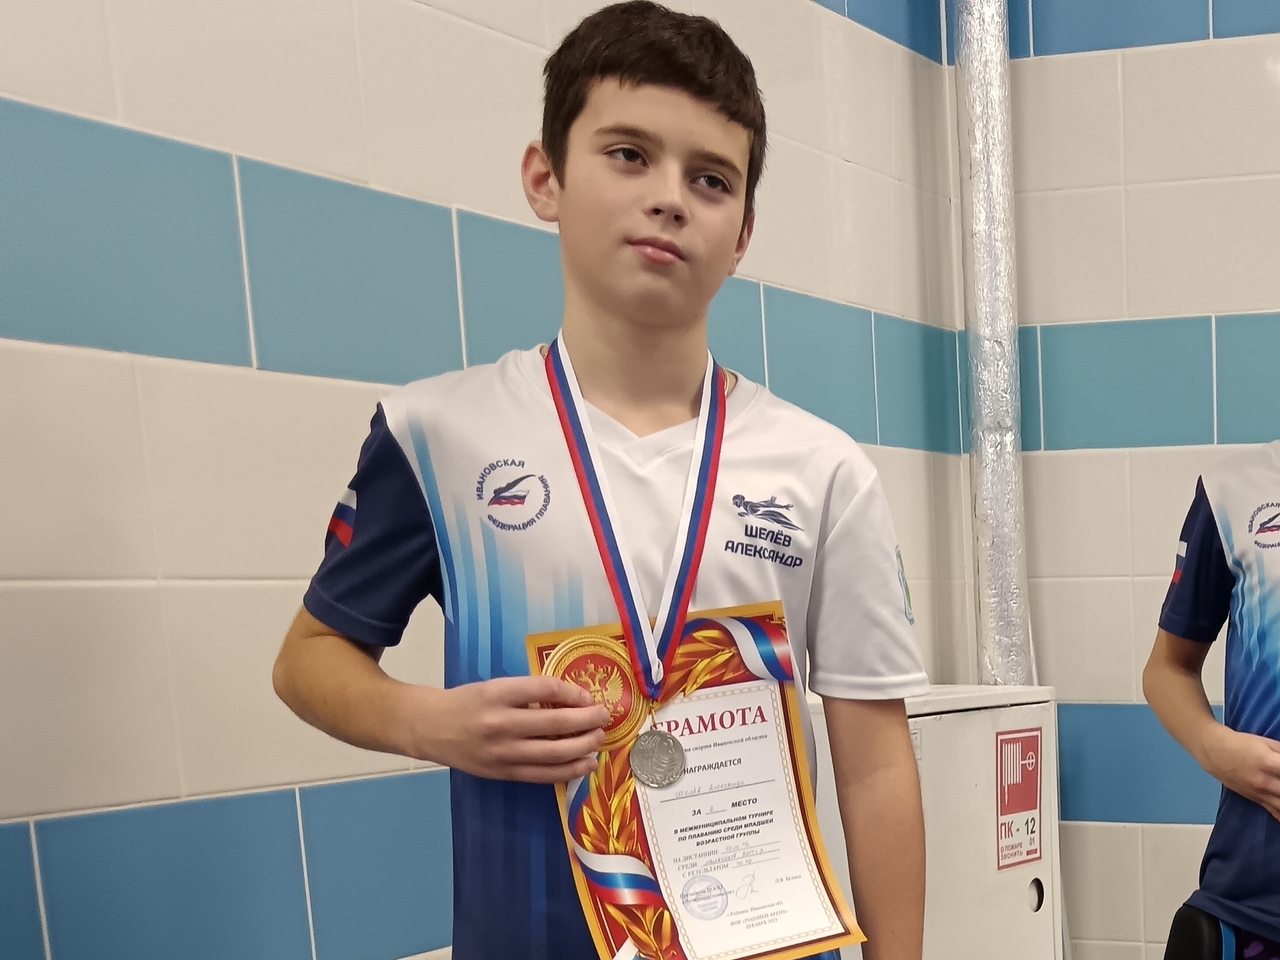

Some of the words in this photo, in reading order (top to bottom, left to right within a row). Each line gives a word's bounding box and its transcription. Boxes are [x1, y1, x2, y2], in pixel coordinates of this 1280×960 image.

[476, 459, 525, 500] ИВАНОВСКАЯ
[487, 514, 537, 531] ФЕДЕРАЦИЯ
[535, 475, 551, 520] ПЛАВАНИЯ
[744, 523, 792, 548] ШЕЛЁВ
[724, 540, 803, 569] АЛЕКСАНДР
[683, 758, 742, 775] НАГРАЖДАЕТСЯ
[731, 798, 758, 808] МЕСТО
[680, 815, 747, 833] МЕЖМУНИЦИПАЛЬНОМ
[748, 810, 774, 820] ТУРНИРЕ
[688, 829, 722, 840] ПЛАВАНИЮ
[723, 825, 743, 833] СРЕДИ
[744, 818, 774, 829] МЛАДШЕЙ
[1000, 820, 1014, 840] ПК
[1024, 817, 1036, 836] 12
[696, 834, 735, 847] ВОЗРАСТНОЙ
[736, 829, 760, 839] ГРУППЫ
[1005, 842, 1023, 851] ПОЖАРЕ
[1001, 850, 1023, 860] ЗВОНИТЬ
